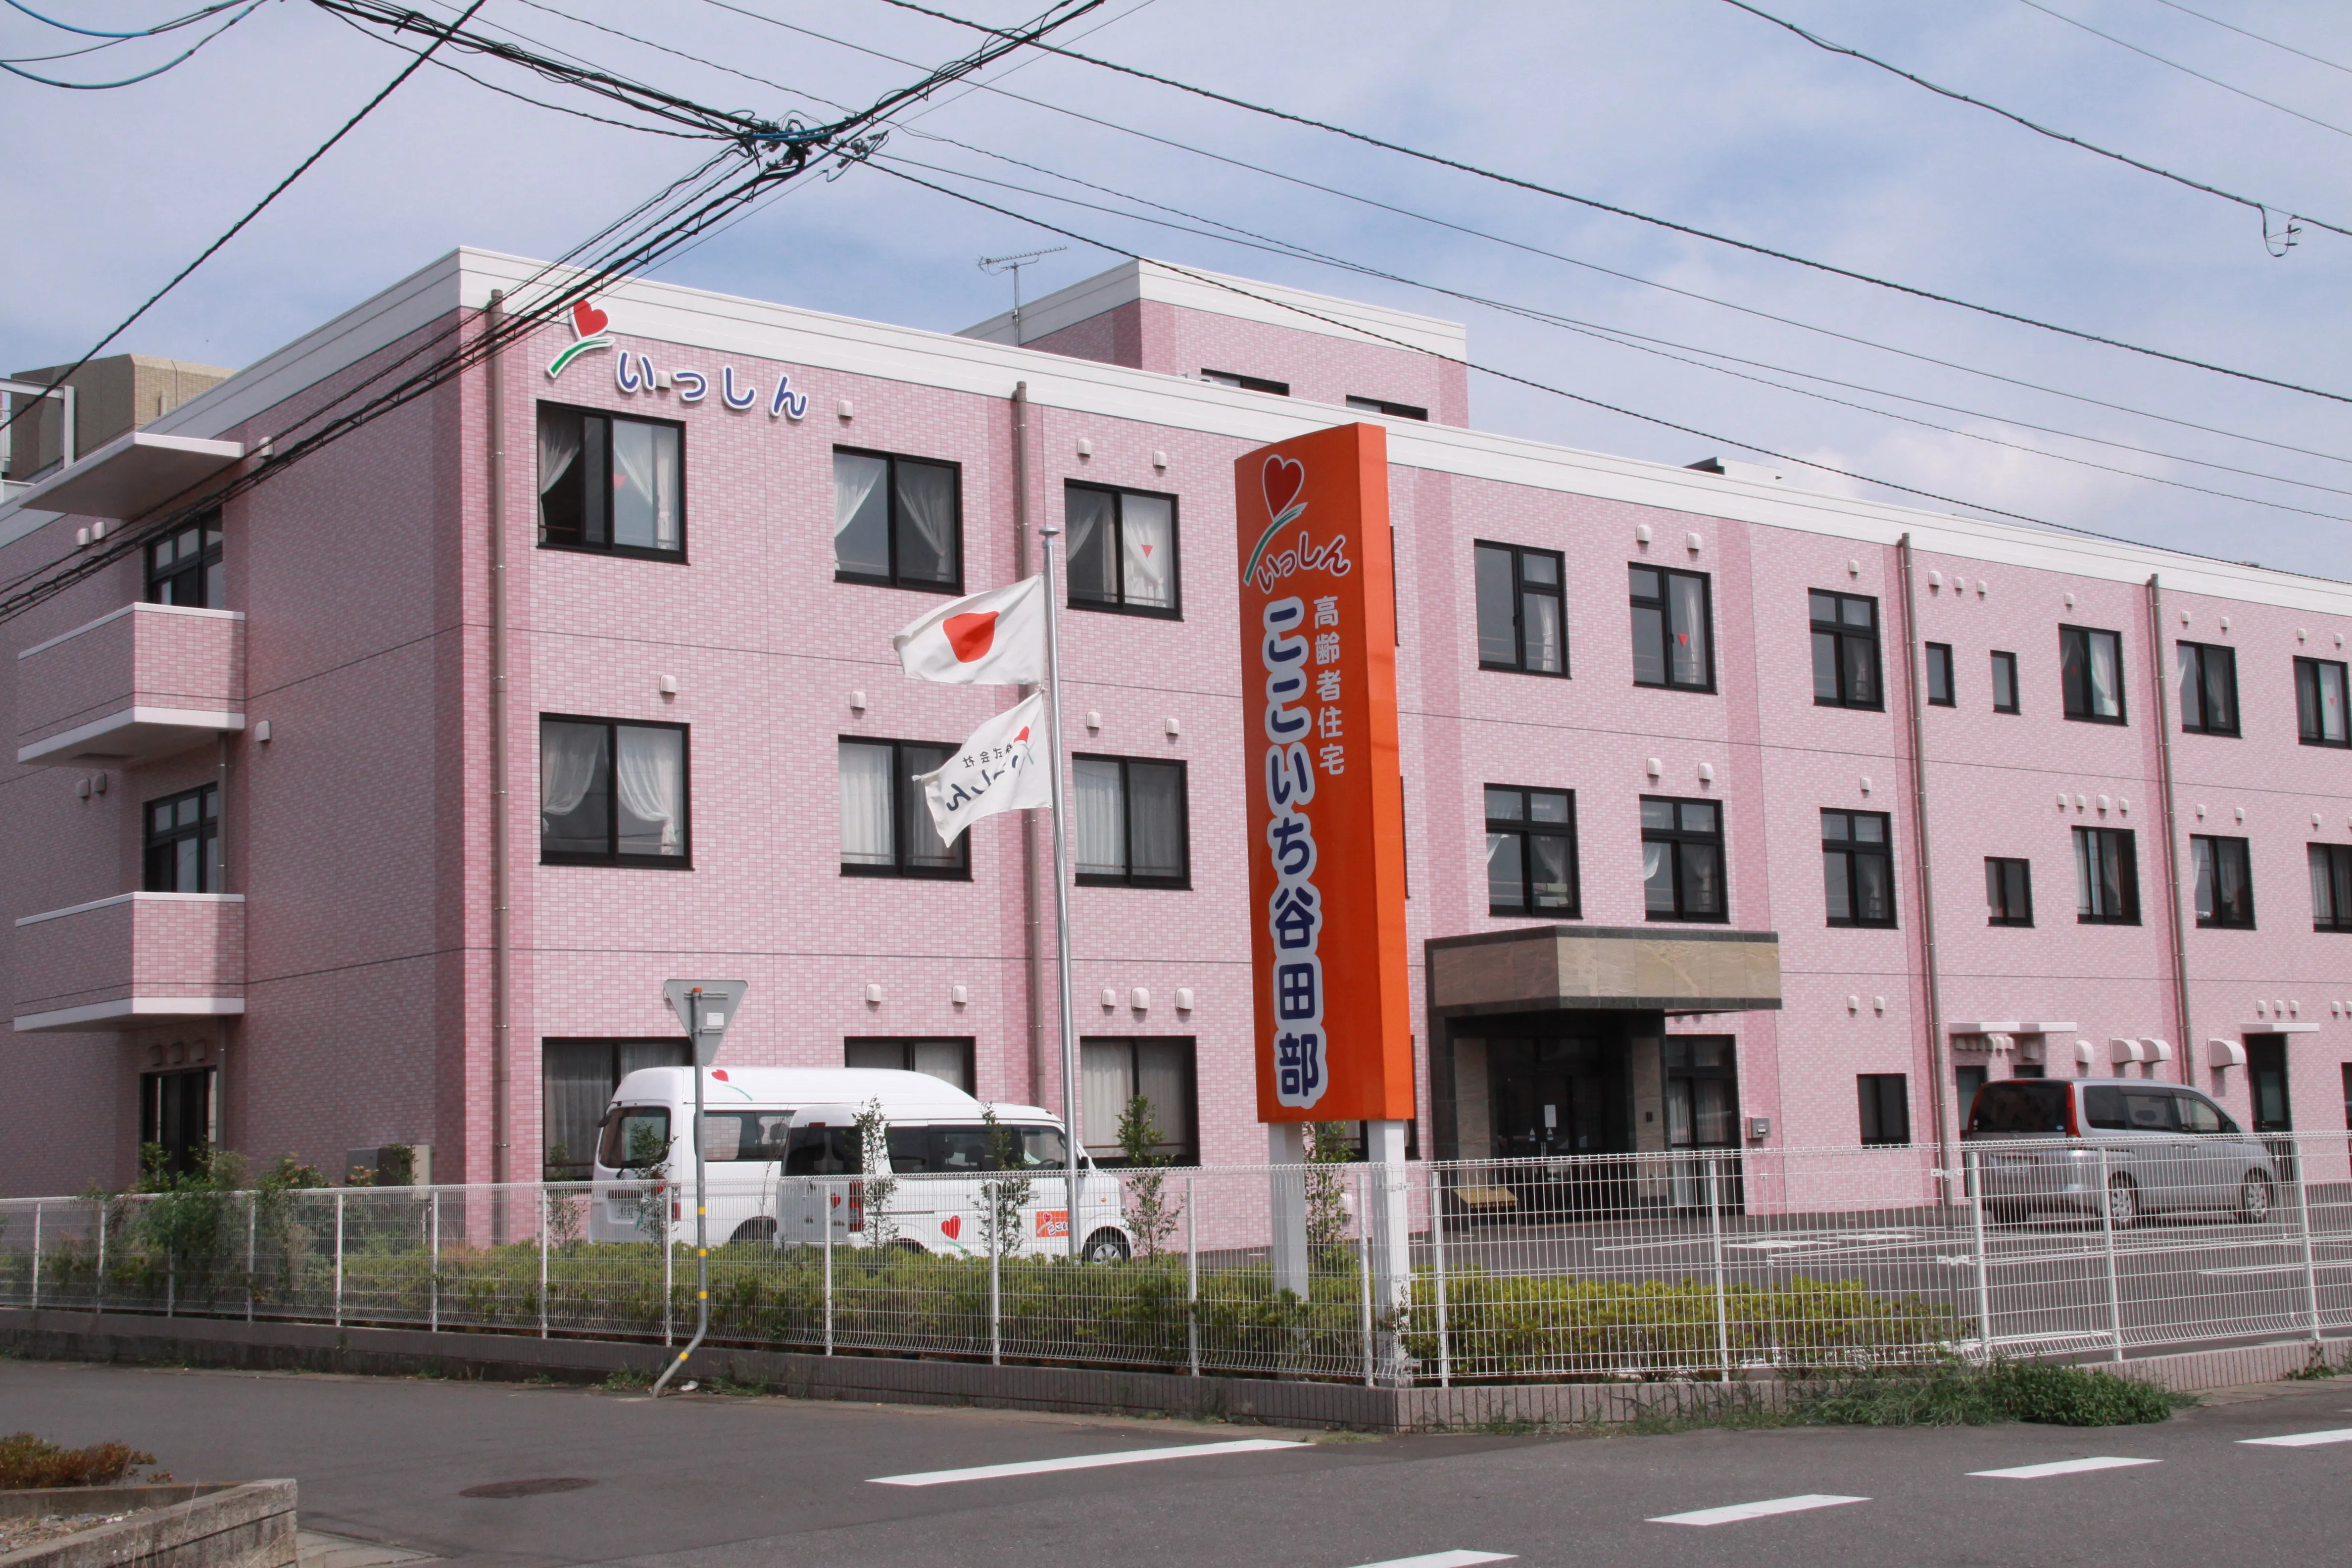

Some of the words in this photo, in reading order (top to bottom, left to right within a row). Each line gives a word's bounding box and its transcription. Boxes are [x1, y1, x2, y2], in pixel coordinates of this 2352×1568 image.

[615, 349, 809, 420] いっしん
[1257, 531, 1351, 594] いっしん
[1313, 594, 1345, 776] 高齢者住宅
[1263, 597, 1327, 1108] ここいち谷田部
